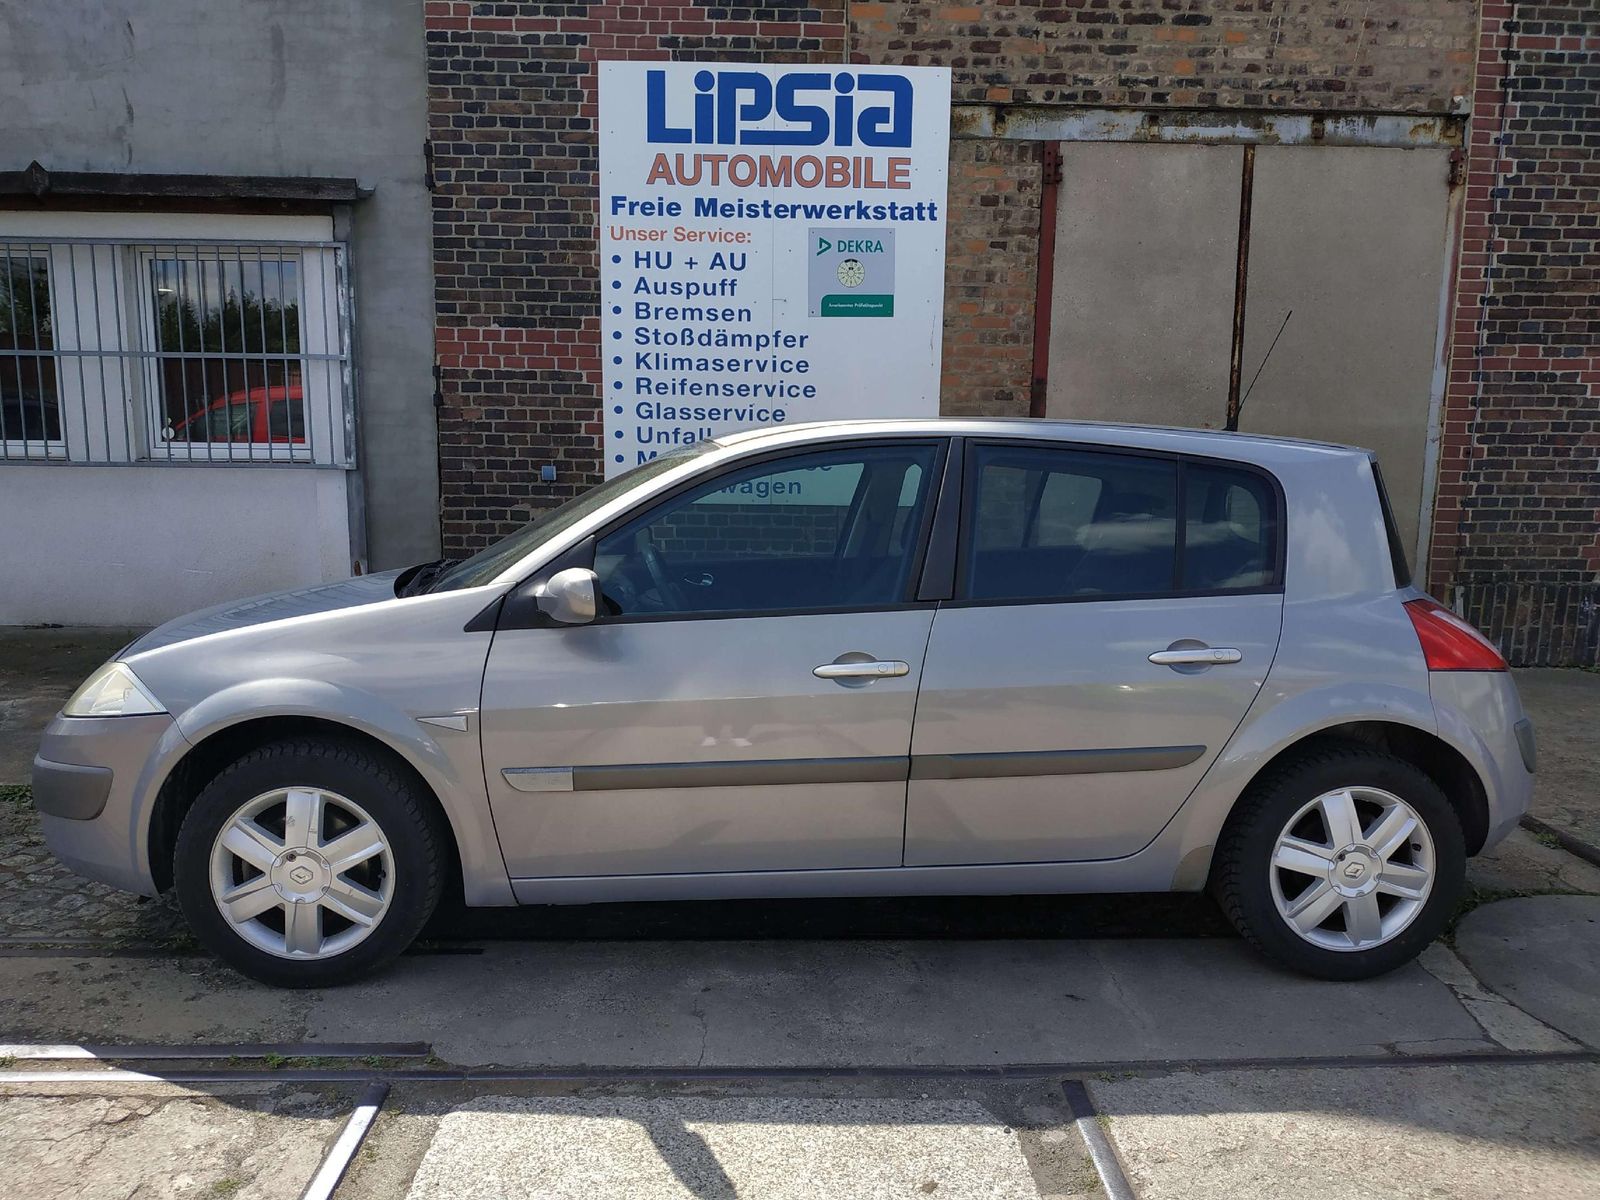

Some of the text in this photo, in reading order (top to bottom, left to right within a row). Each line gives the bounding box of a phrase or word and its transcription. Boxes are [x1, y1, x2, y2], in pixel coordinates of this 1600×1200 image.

[646, 153, 912, 190] AUTOMOBILE
[611, 195, 938, 221] Freie Meisterwerkstatt
[610, 226, 752, 244] Unser Service:
[837, 239, 884, 253] DEKRA
[633, 250, 748, 272] HU + AU
[633, 276, 738, 300] Auspuff
[634, 301, 752, 322] Bremsen
[634, 326, 809, 352] Stoßdämpfer
[635, 351, 810, 374] Klimaservice
[635, 376, 817, 398] Reifenservice
[635, 401, 787, 423] Glasservice
